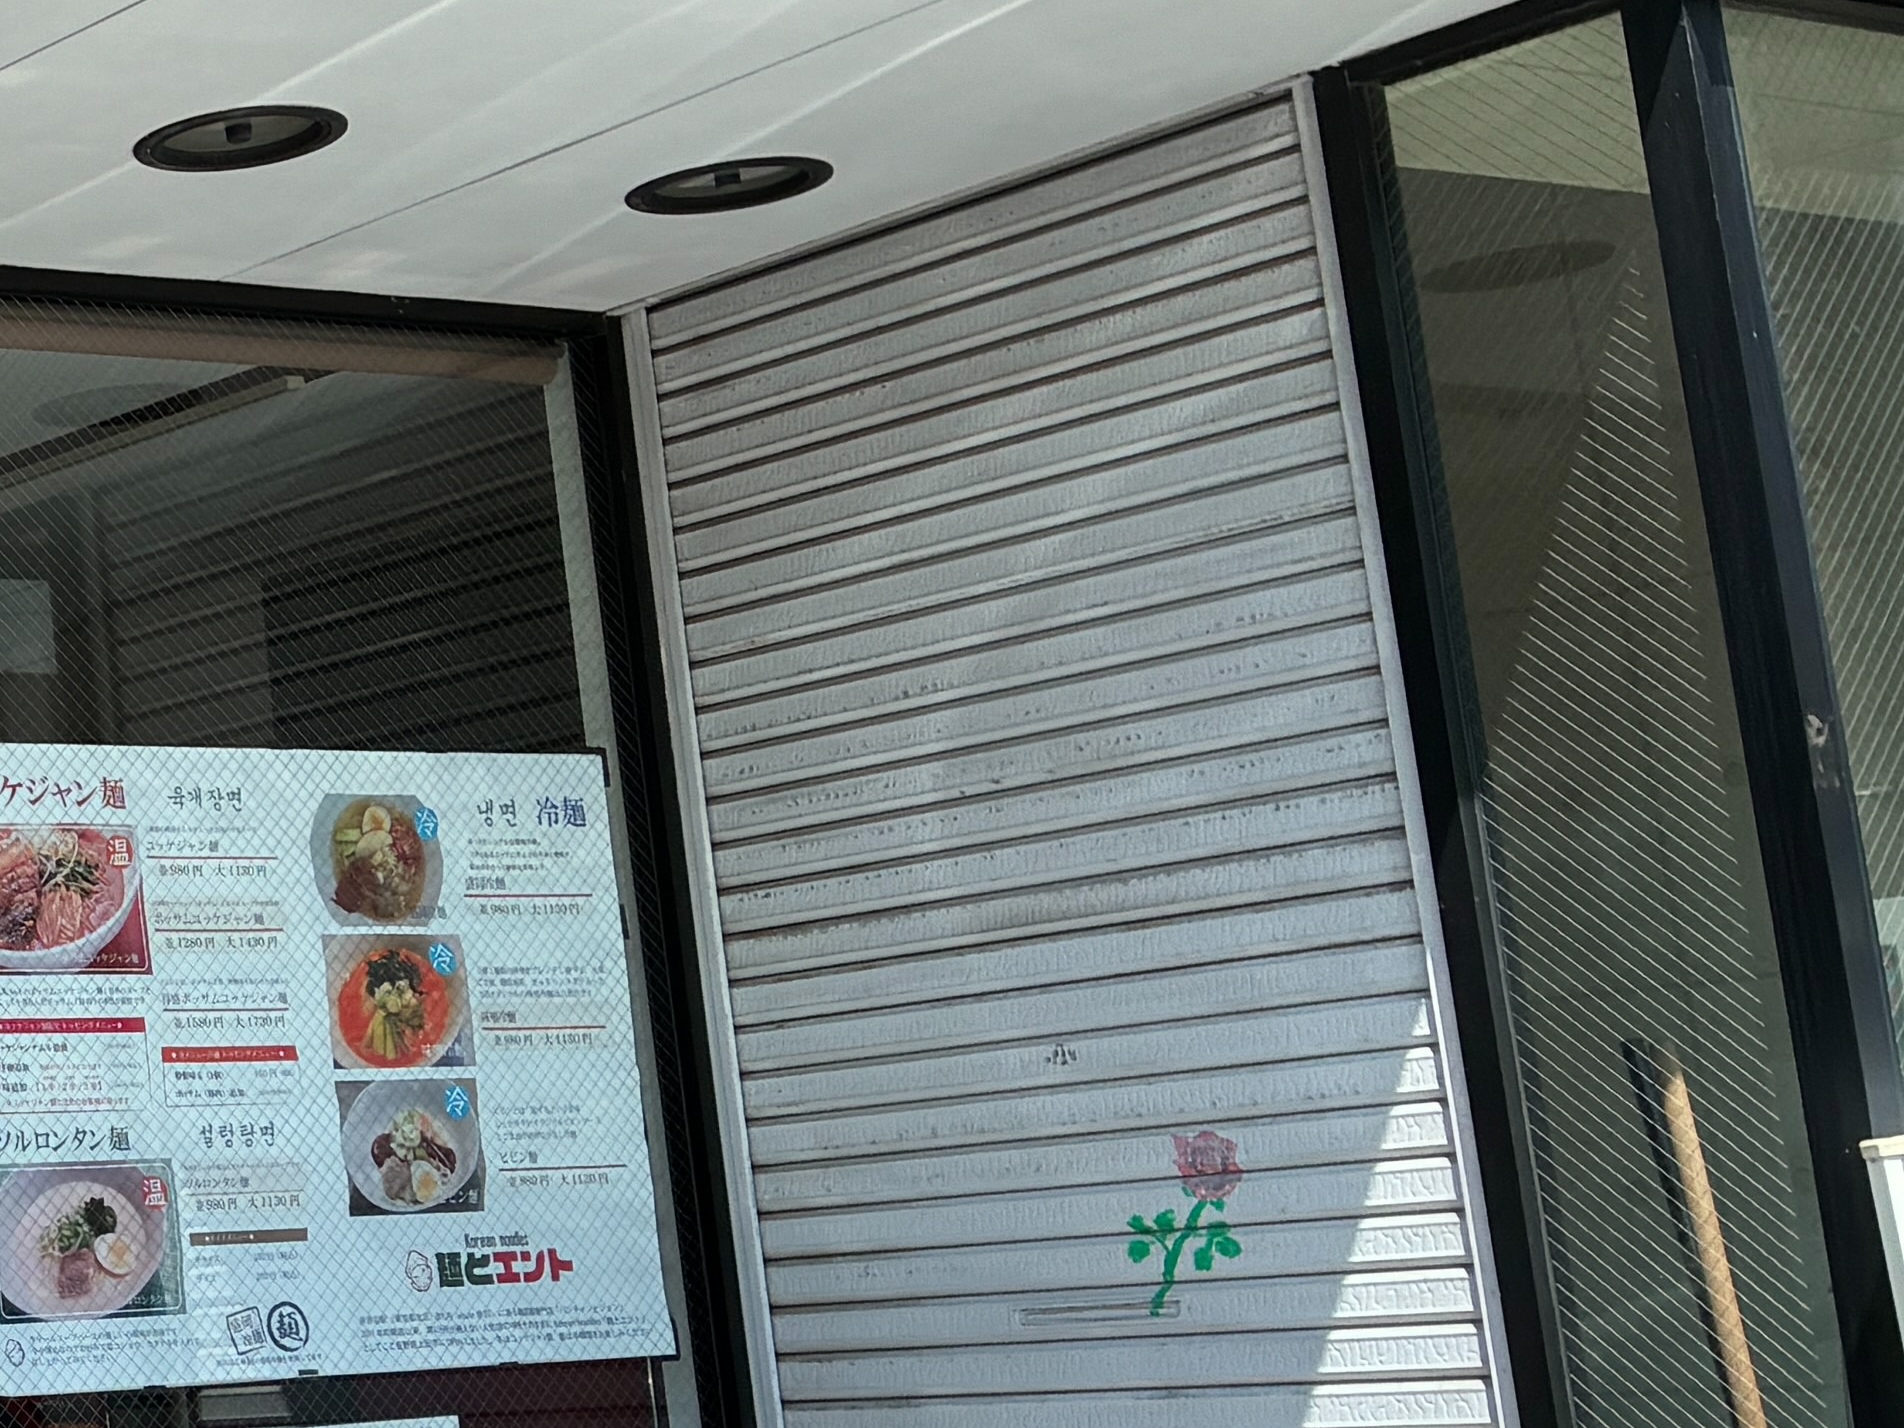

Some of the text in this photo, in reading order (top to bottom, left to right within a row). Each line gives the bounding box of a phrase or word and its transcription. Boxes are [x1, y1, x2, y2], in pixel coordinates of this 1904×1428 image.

[536, 796, 587, 828] 冷麺
[429, 943, 454, 972] 冷
[446, 1085, 468, 1117] 冷
[435, 1248, 574, 1288] 麺とエント
